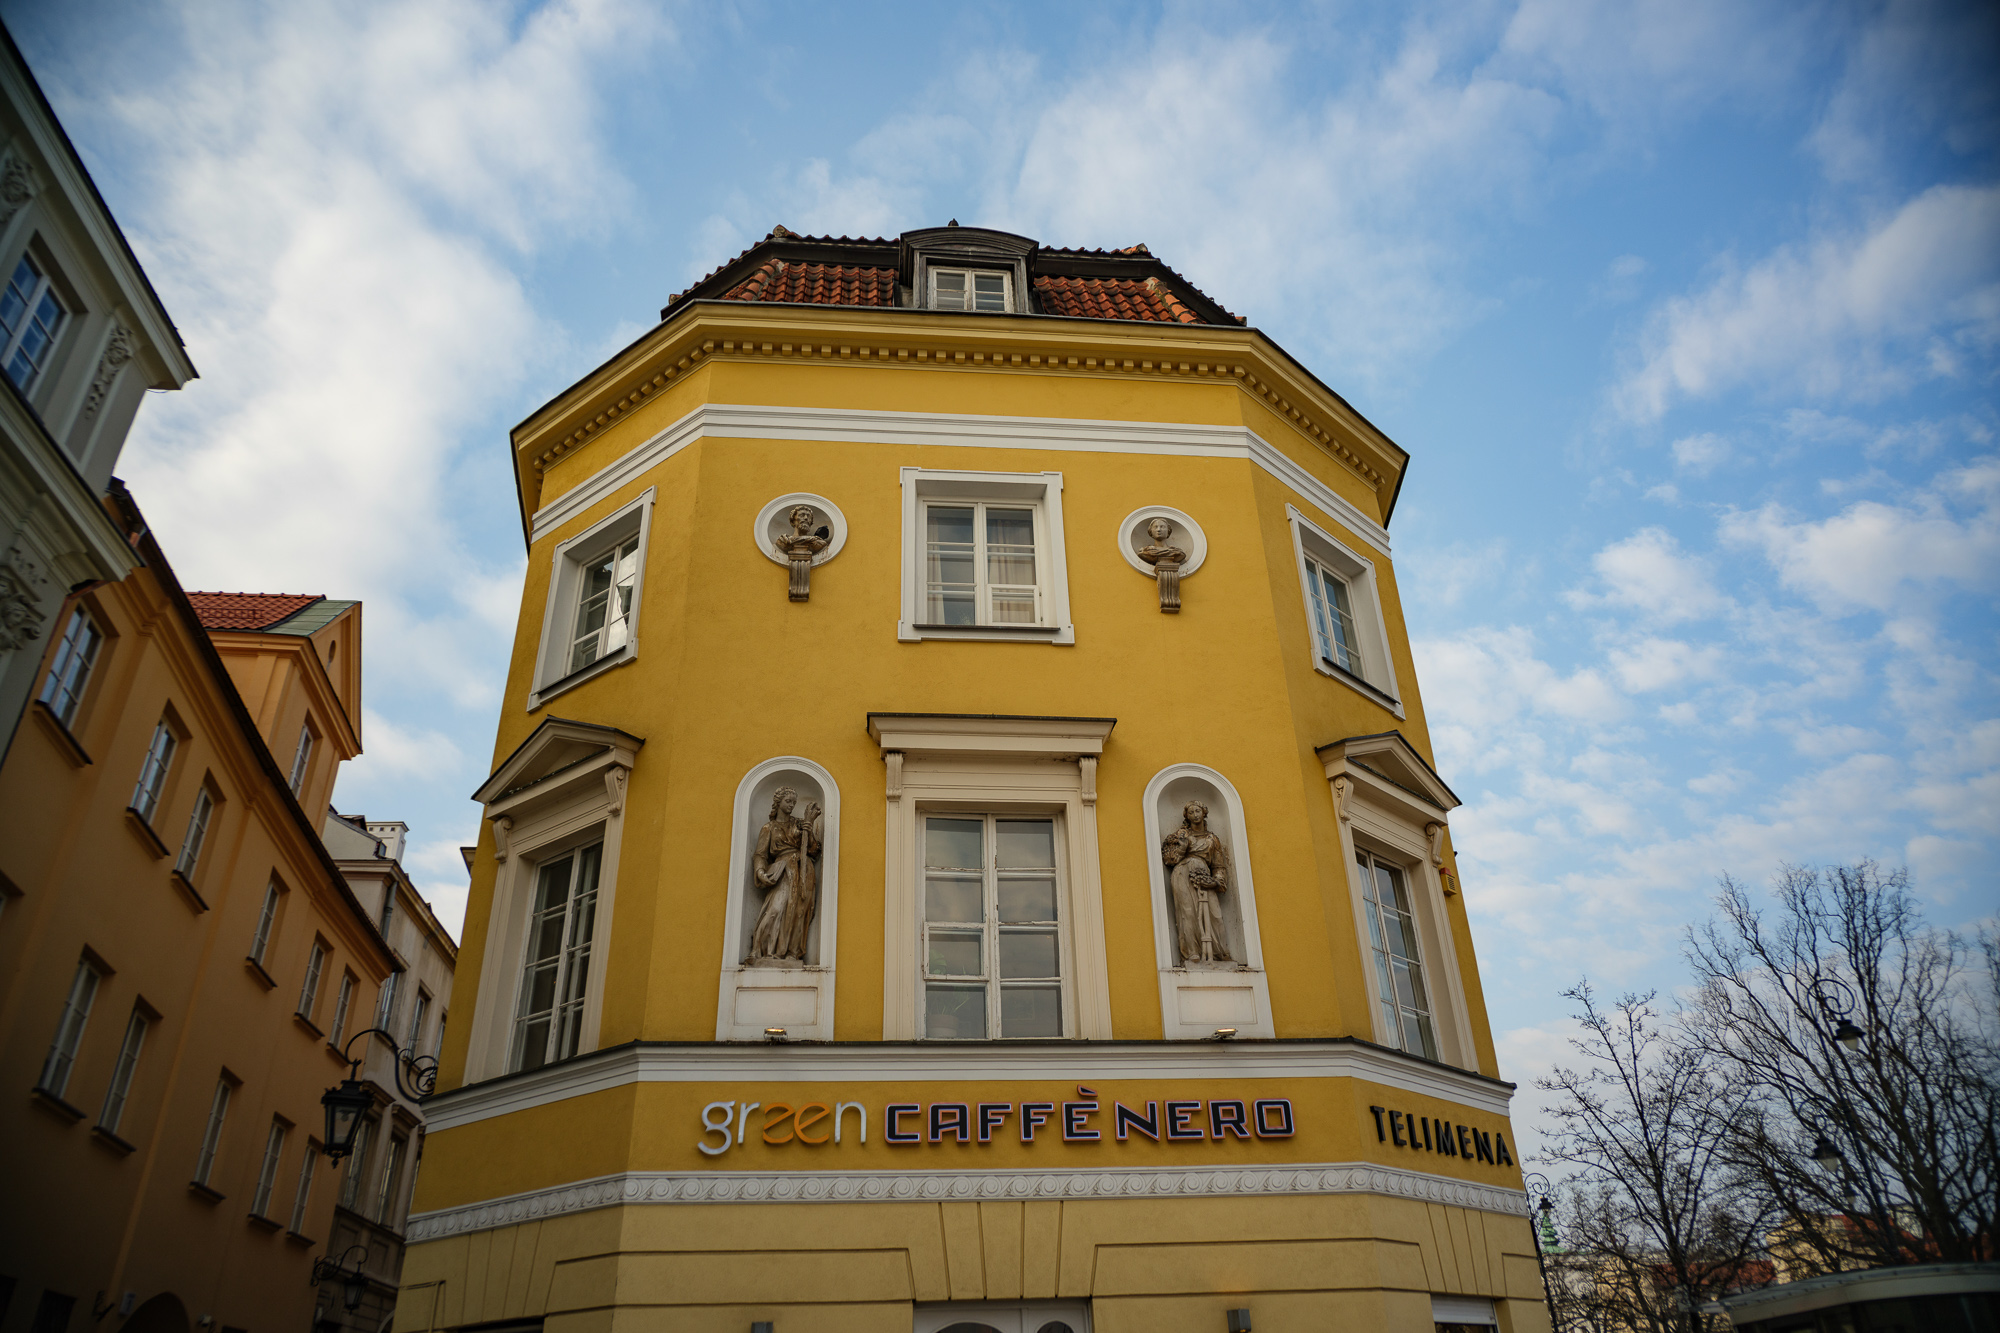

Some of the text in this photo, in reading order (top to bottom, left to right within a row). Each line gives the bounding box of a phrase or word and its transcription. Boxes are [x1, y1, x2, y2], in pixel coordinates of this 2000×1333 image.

[697, 1084, 1296, 1156] green CAFFÈ NERO
[1369, 1105, 1514, 1167] TELIMENA
